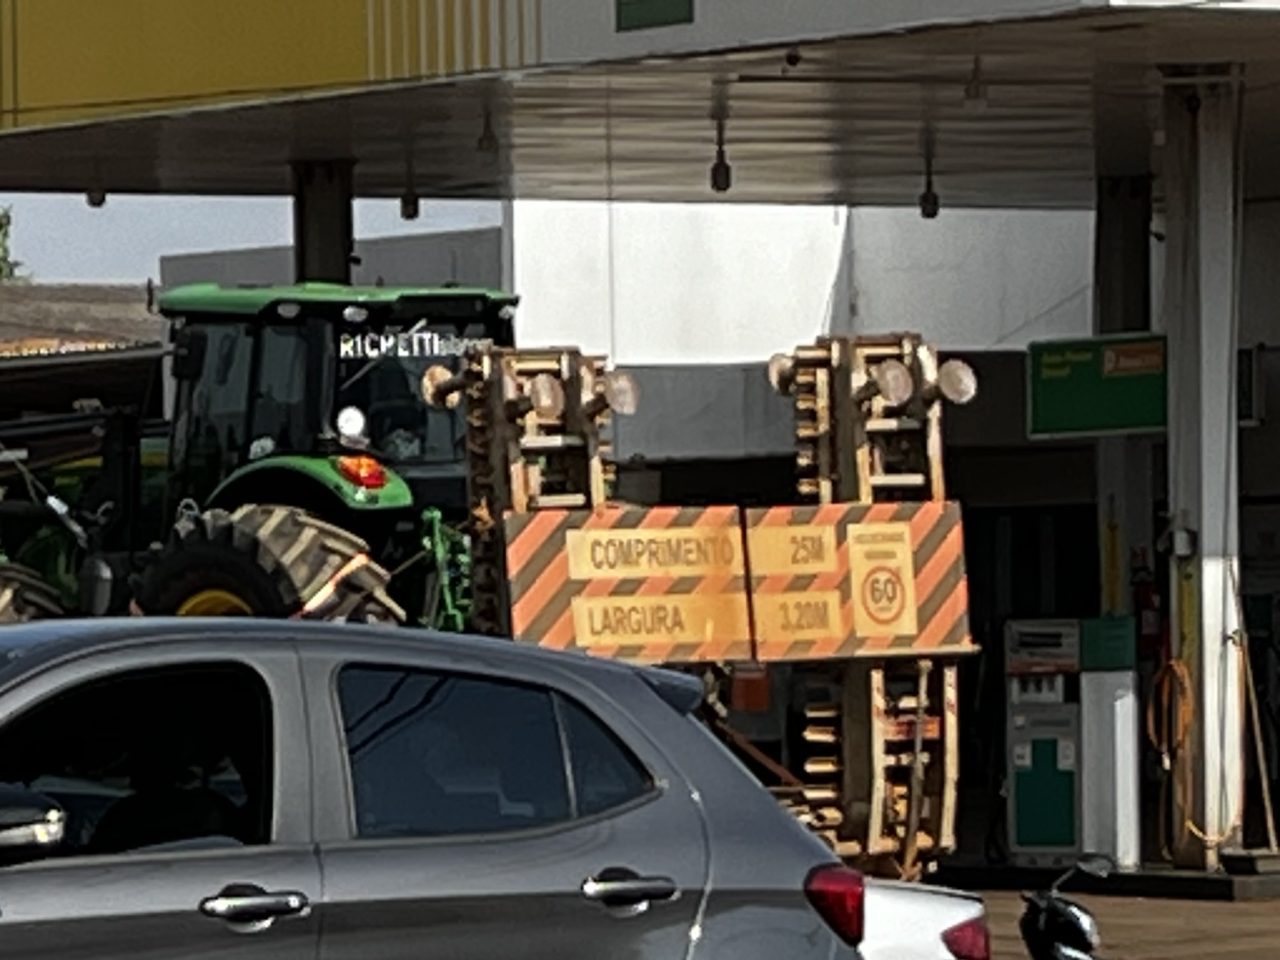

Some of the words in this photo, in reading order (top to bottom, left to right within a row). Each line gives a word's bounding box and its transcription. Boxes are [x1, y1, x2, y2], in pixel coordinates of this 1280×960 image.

[590, 533, 735, 570] COMPRIMENTO
[789, 535, 826, 565] 25M
[870, 577, 897, 604] 60
[588, 604, 685, 636] LARGURA
